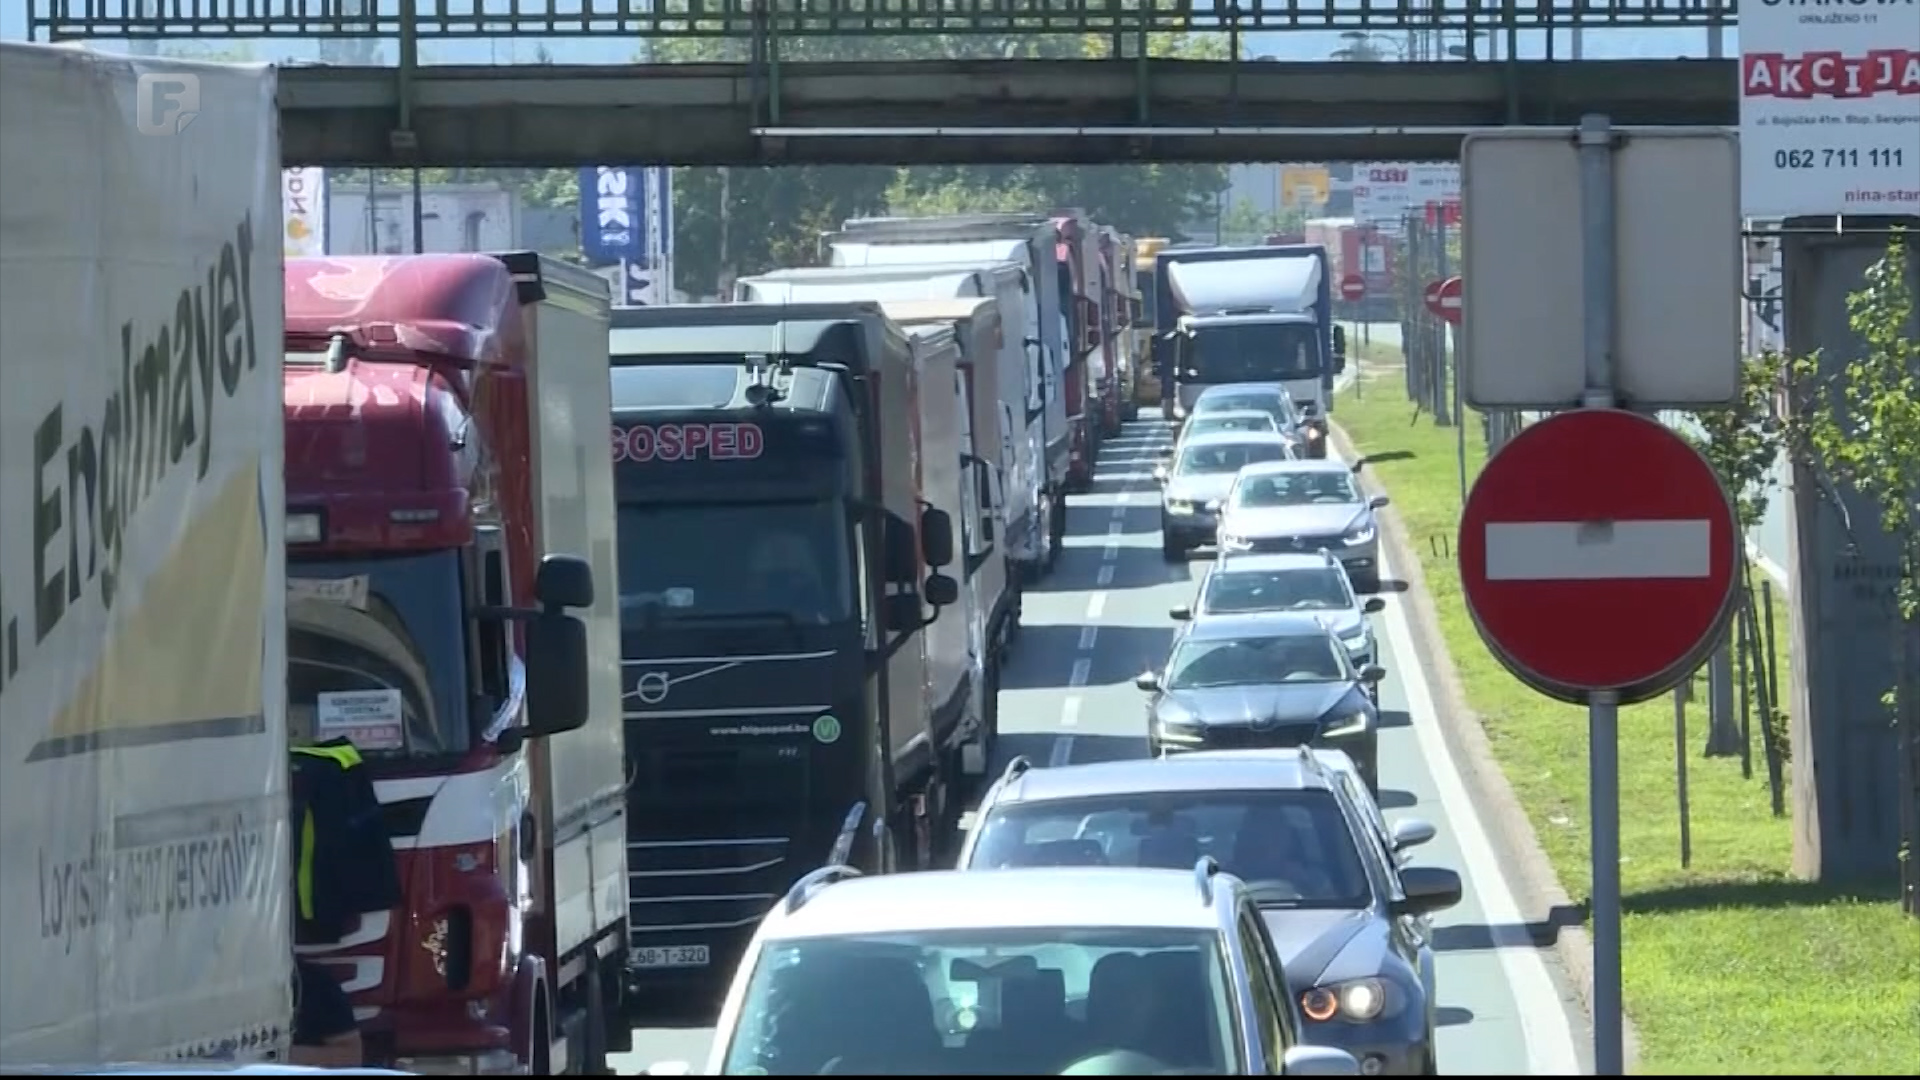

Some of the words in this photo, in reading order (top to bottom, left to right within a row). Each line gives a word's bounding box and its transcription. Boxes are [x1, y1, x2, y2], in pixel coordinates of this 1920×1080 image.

[1748, 56, 1920, 94] AKCIJA
[1775, 148, 1815, 169] 062
[1821, 148, 1858, 169] 711
[1868, 147, 1903, 168] 111
[34, 208, 256, 646] Englmayer
[632, 947, 706, 963] 68-T-320
